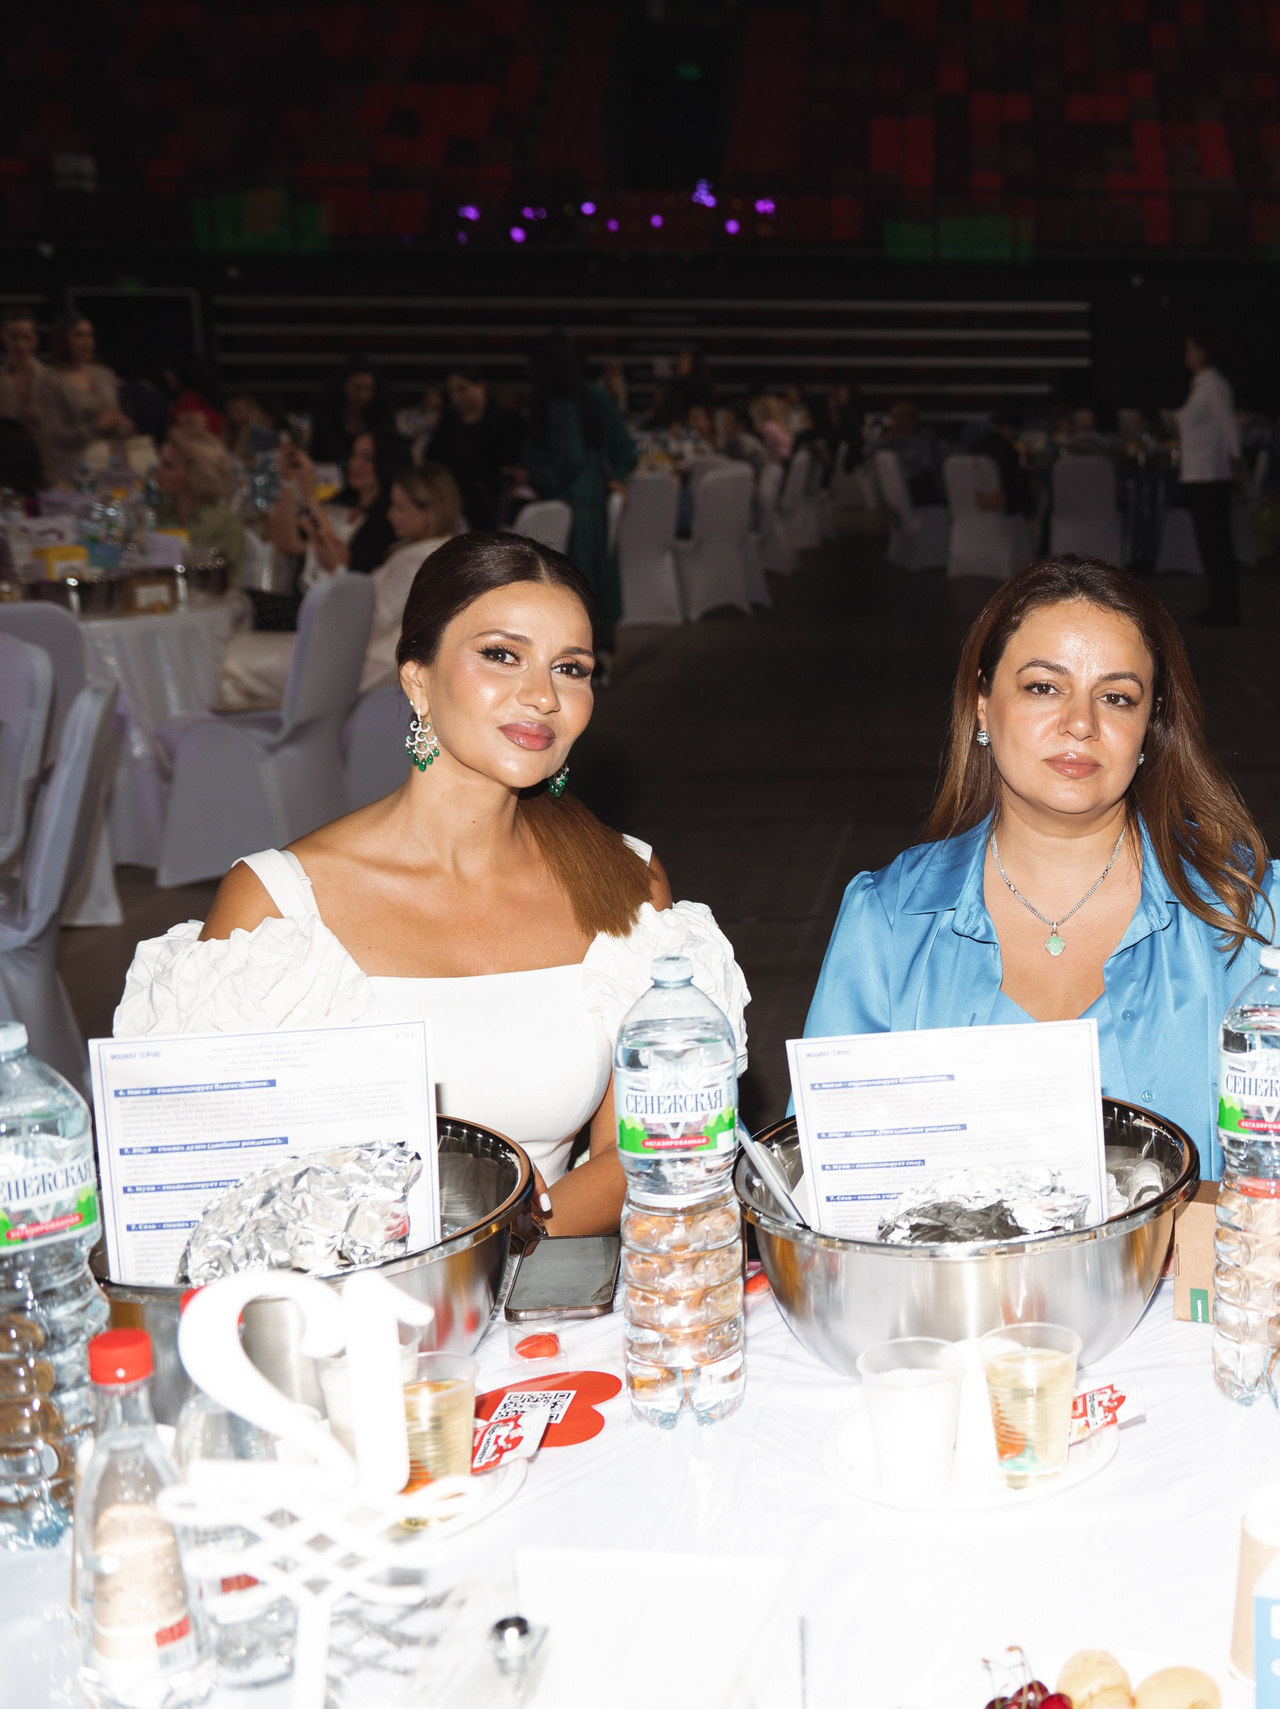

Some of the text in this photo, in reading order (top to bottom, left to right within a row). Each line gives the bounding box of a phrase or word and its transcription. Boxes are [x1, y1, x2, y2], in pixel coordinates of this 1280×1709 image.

[625, 1088, 723, 1115] СЕНЕЖСКАЯ
[644, 1137, 707, 1147] НЕГАЗИРОВАННАЯ
[0, 1158, 93, 1203] ЕНЕЖСКАЯ
